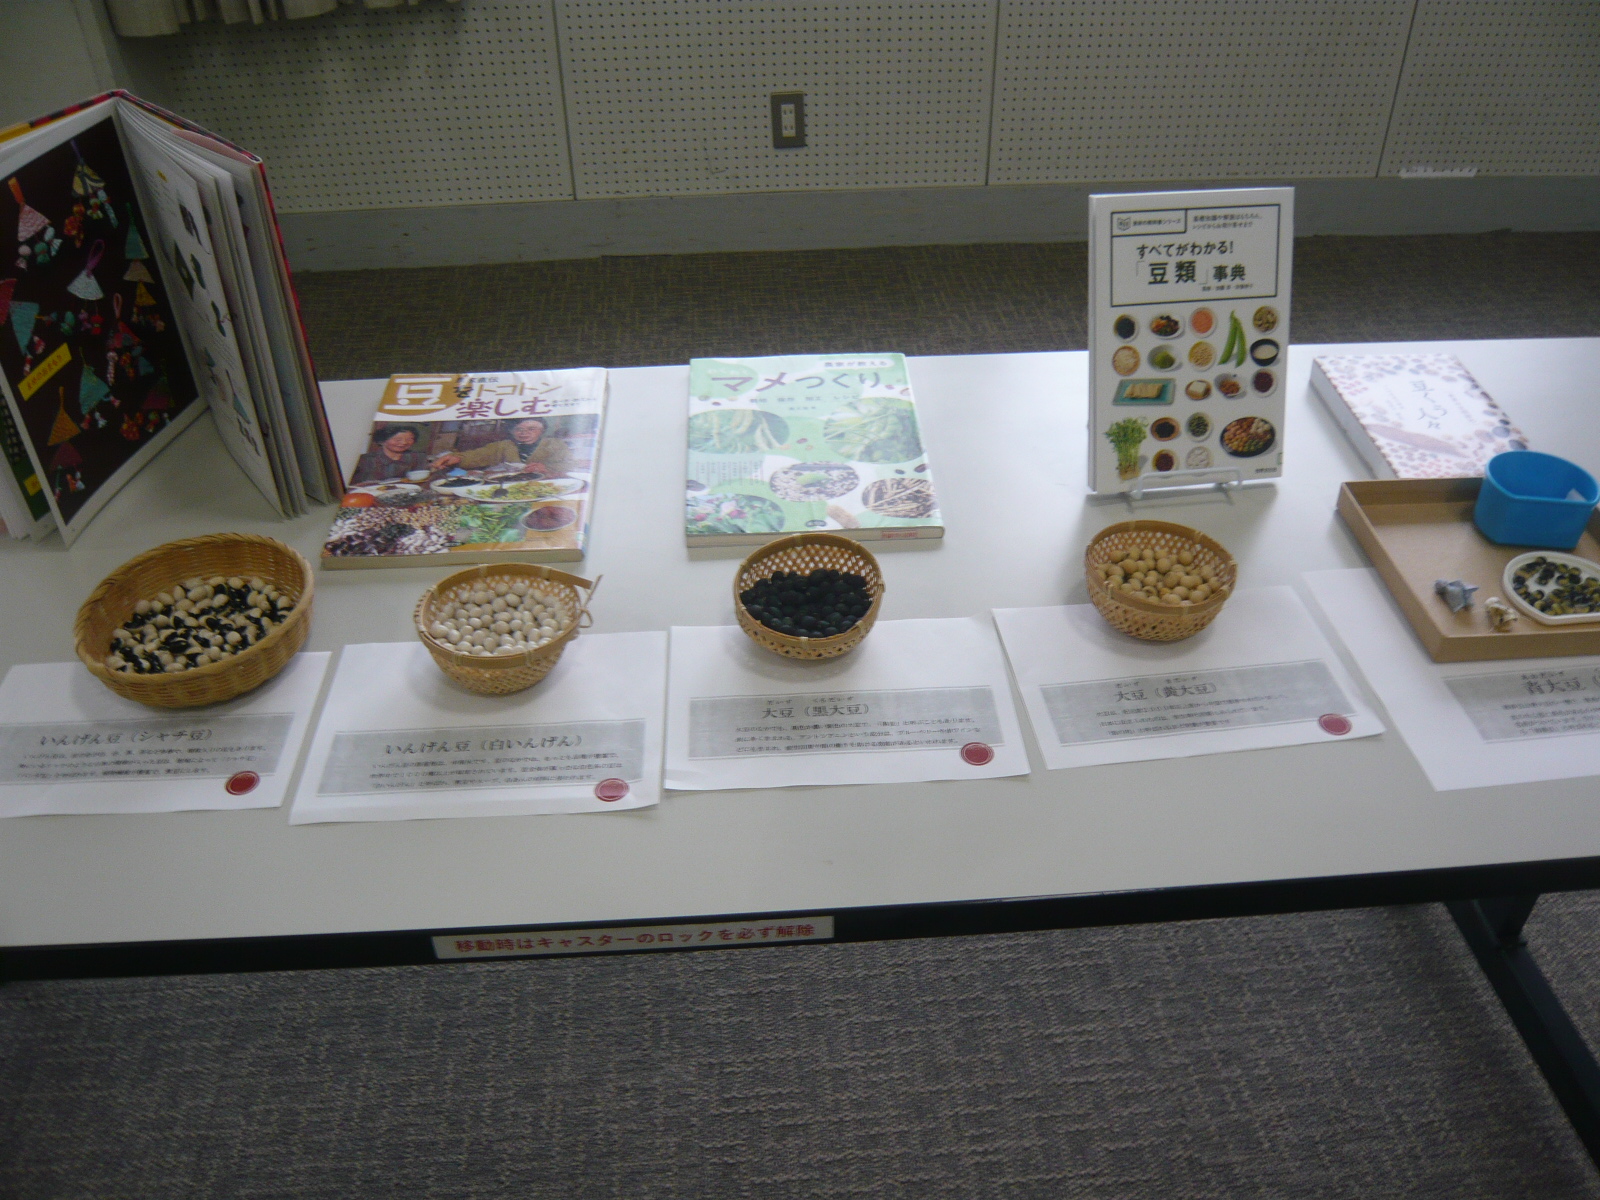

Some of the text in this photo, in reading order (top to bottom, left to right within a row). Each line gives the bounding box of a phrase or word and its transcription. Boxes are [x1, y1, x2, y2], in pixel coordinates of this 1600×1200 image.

[712, 372, 880, 392] マメつくり
[456, 396, 552, 418] 楽しむ
[455, 923, 815, 953] 移動時はキャスターのロックを必ず解除
